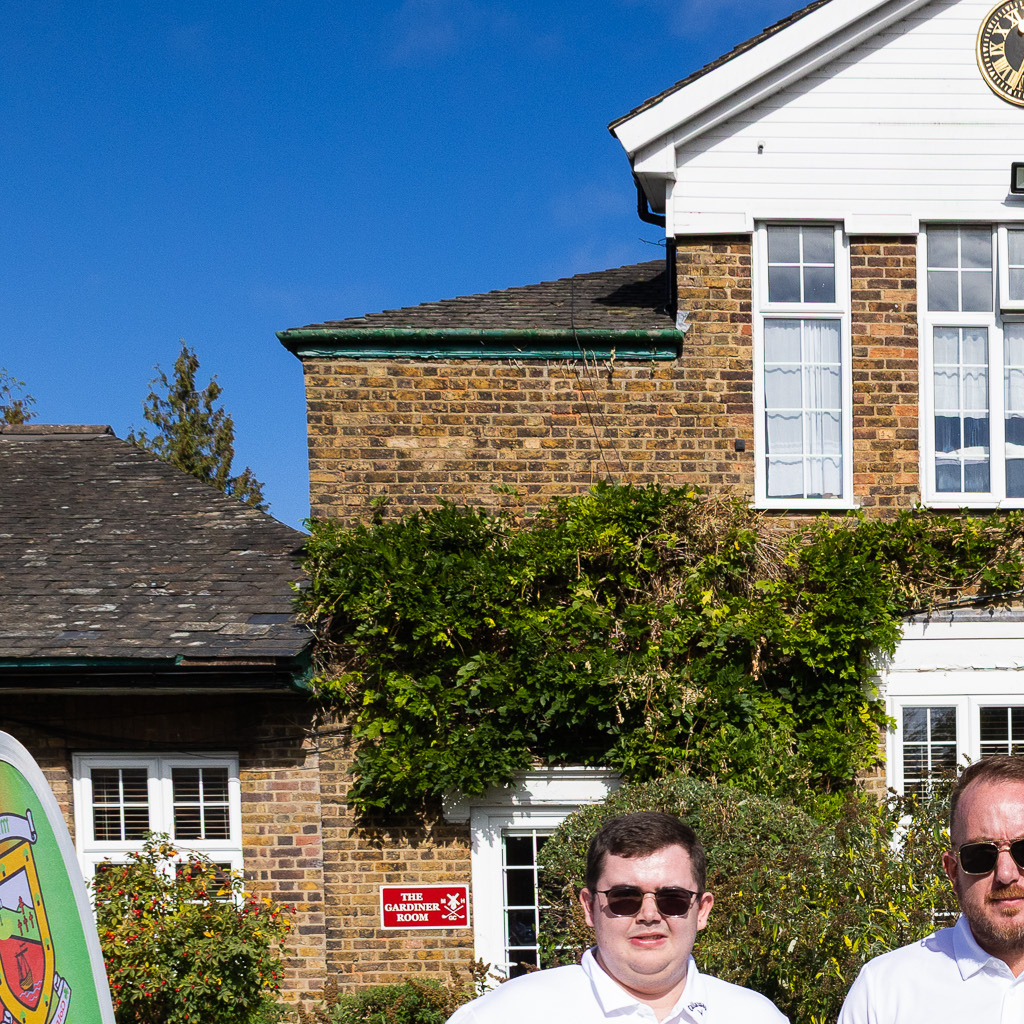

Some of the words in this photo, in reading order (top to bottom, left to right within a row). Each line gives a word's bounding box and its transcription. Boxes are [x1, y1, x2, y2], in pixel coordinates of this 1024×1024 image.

[400, 893, 423, 901] THE
[384, 903, 441, 912] GARDINER
[397, 913, 429, 922] ROOM
